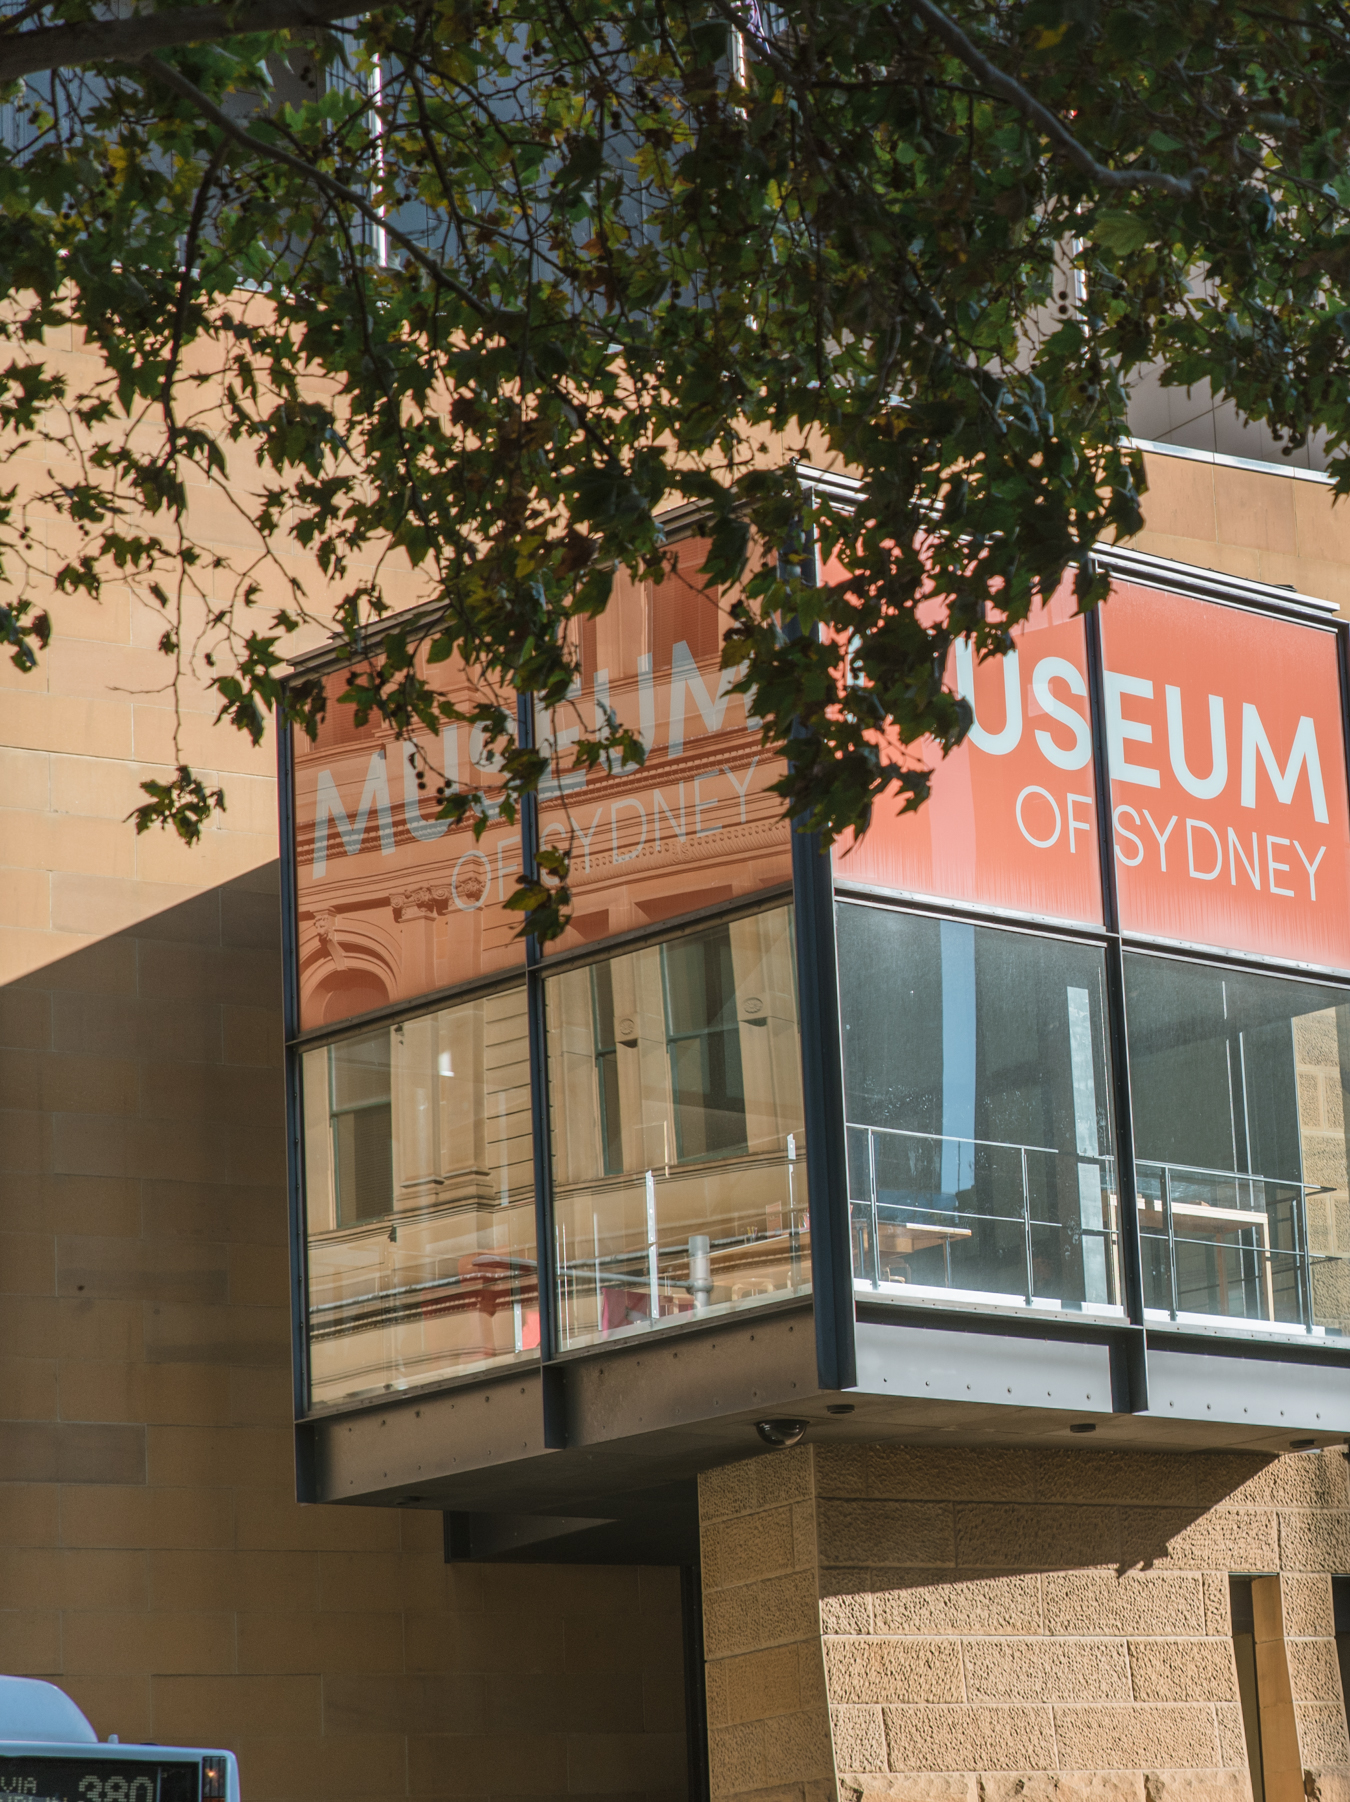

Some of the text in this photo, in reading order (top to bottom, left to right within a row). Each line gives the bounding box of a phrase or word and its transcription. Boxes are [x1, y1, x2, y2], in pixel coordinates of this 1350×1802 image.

[846, 628, 1330, 825] USEUM
[452, 834, 521, 912] OF
[1015, 785, 1327, 902] OF SYDNEY
[0, 1776, 38, 1794] VIA
